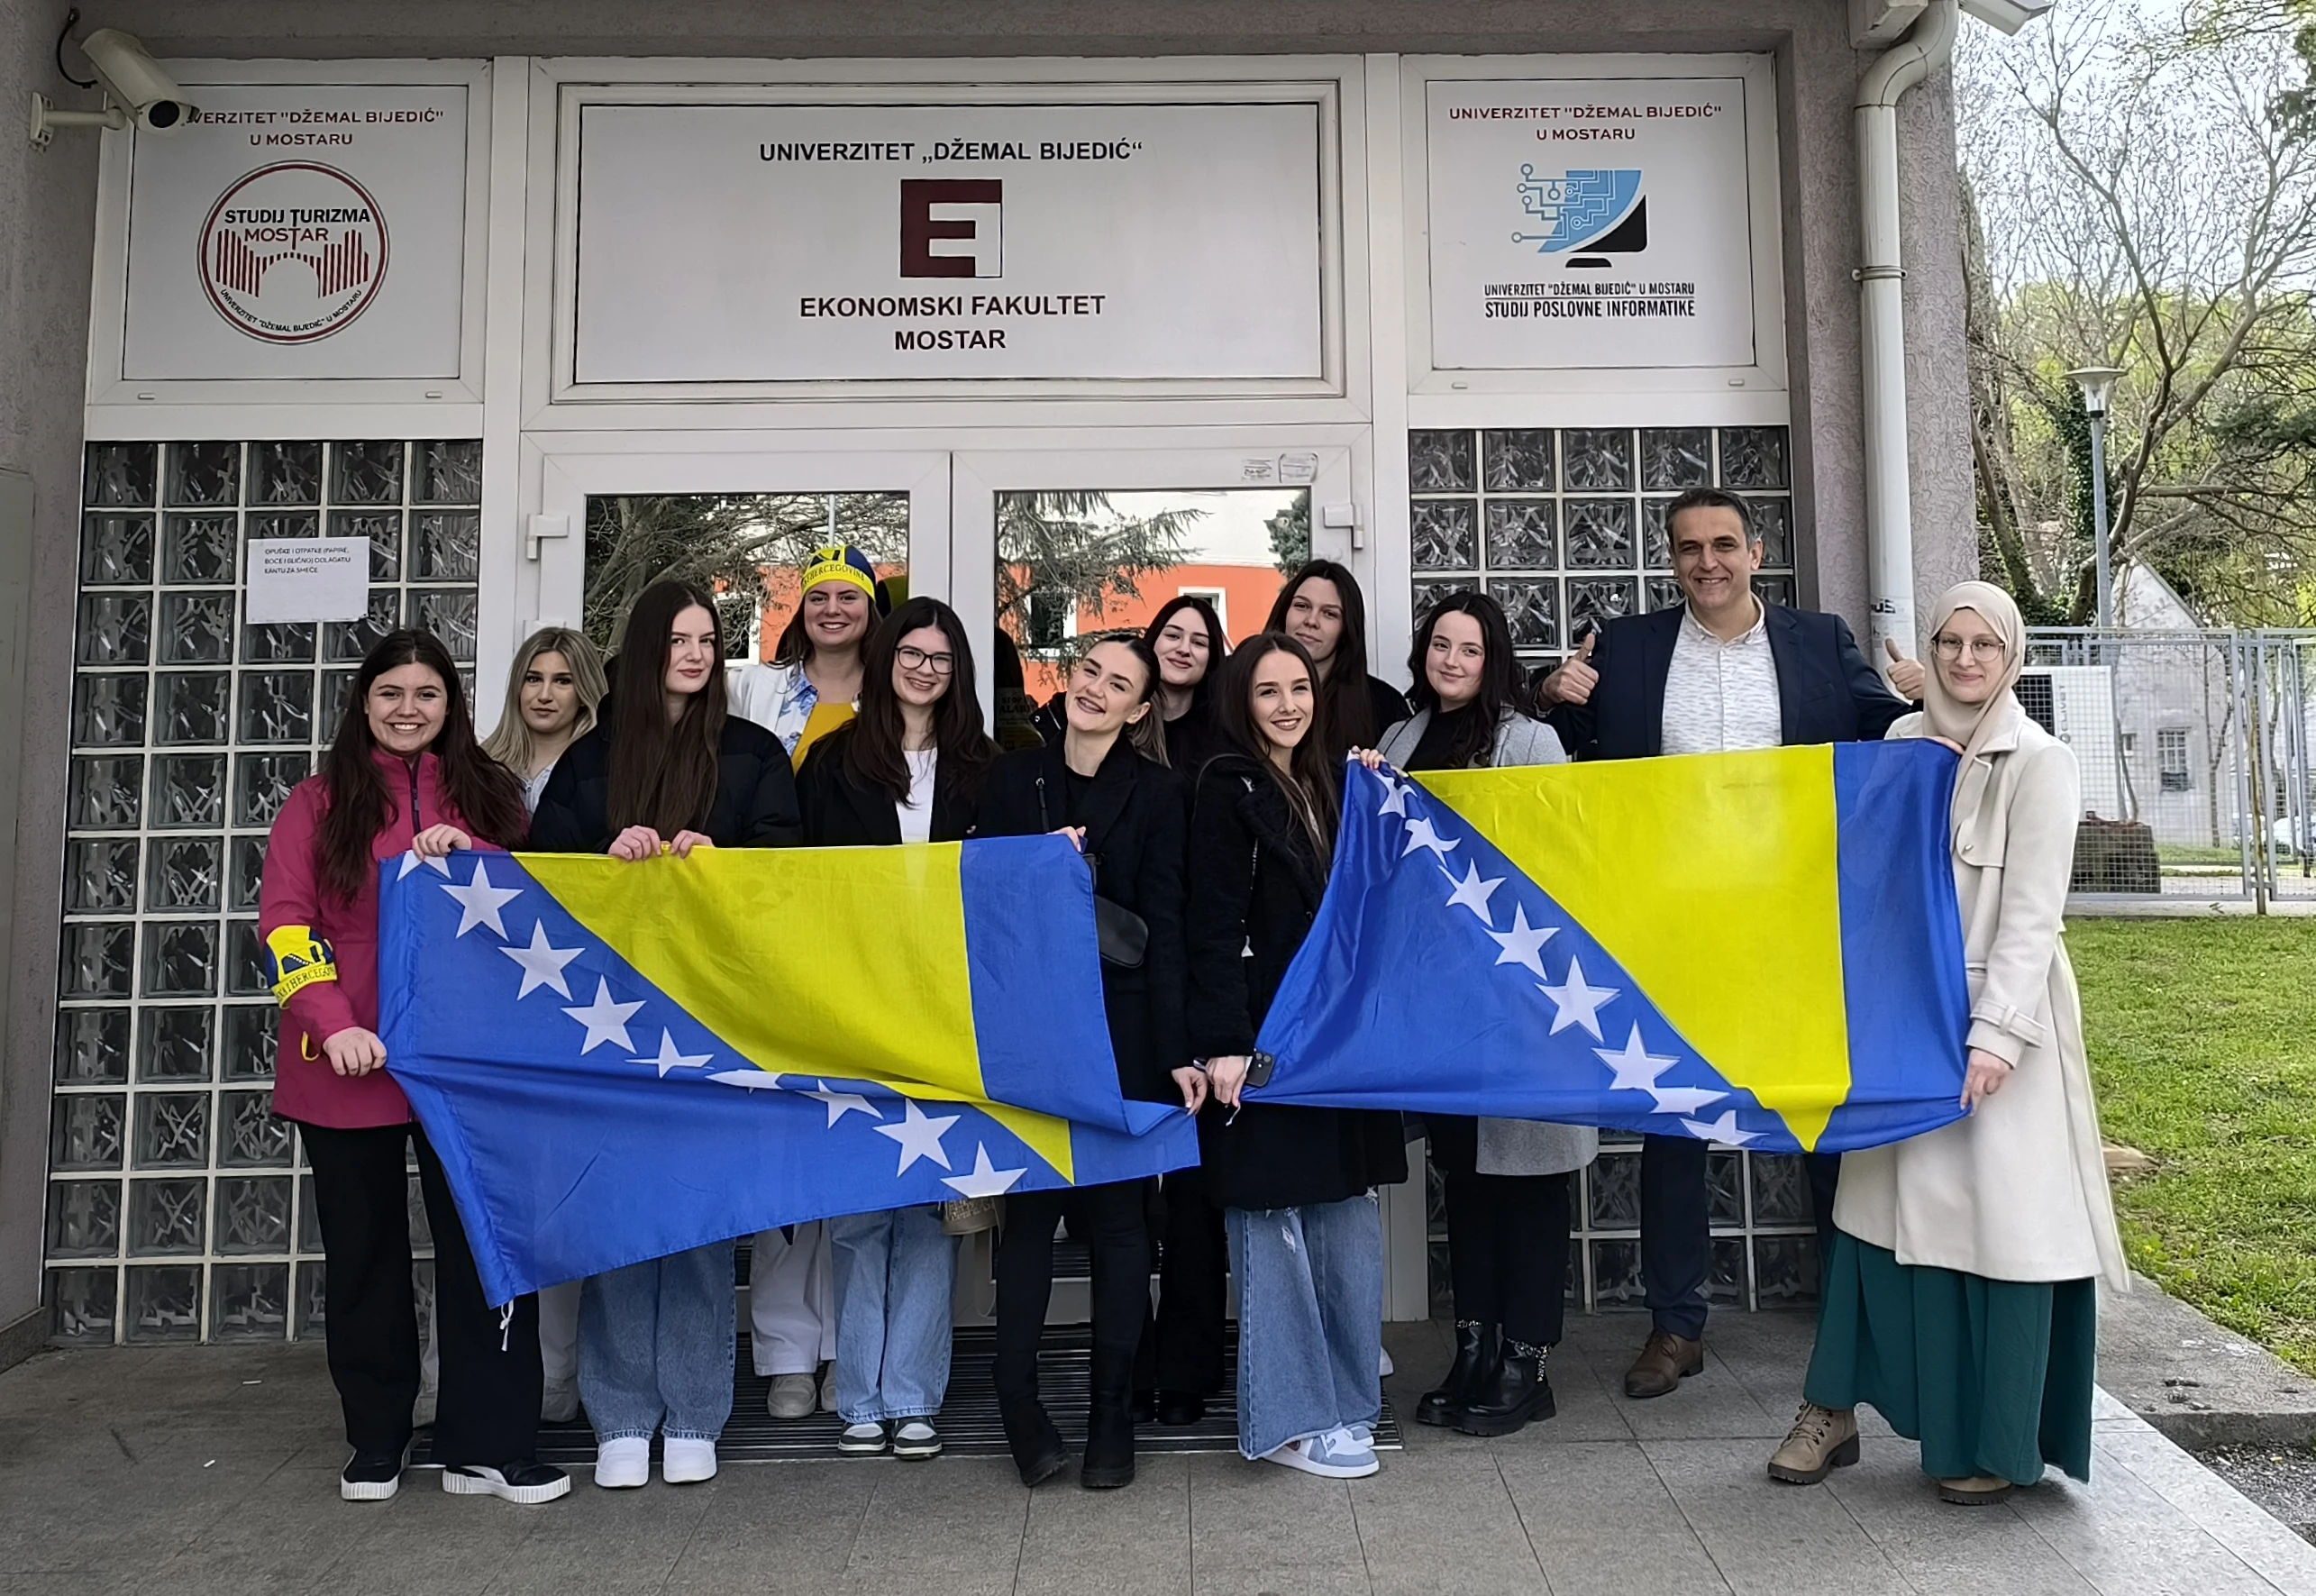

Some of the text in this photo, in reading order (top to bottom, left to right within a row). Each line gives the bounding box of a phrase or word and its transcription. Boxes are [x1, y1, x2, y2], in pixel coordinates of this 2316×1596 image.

[280, 108, 360, 123] "DŽEMAL
[366, 107, 443, 123] BIJEDIĆ"
[1449, 102, 1721, 119] UNIVERZITET "DŽEMAL BIJEDIĆ"
[250, 133, 353, 146] U MOSTARU
[1536, 128, 1636, 141] U MOSTARU
[760, 142, 915, 161] UNIVERZITET
[922, 137, 1031, 164] „DŽEMAL
[224, 208, 370, 227] STUDIJ TURIZMA
[244, 227, 329, 251] MOSTAR
[1484, 283, 1546, 296] UNIVERZITET
[1639, 283, 1646, 295] U
[1649, 282, 1694, 295] MOSTARU
[333, 290, 362, 319] MOSTARU
[800, 295, 1106, 317] EKONOMSKI FAKULTET
[1485, 300, 1695, 317] STUDIJ POSLOVNE INFORMATIKE
[895, 330, 1007, 351] MOSTAR
